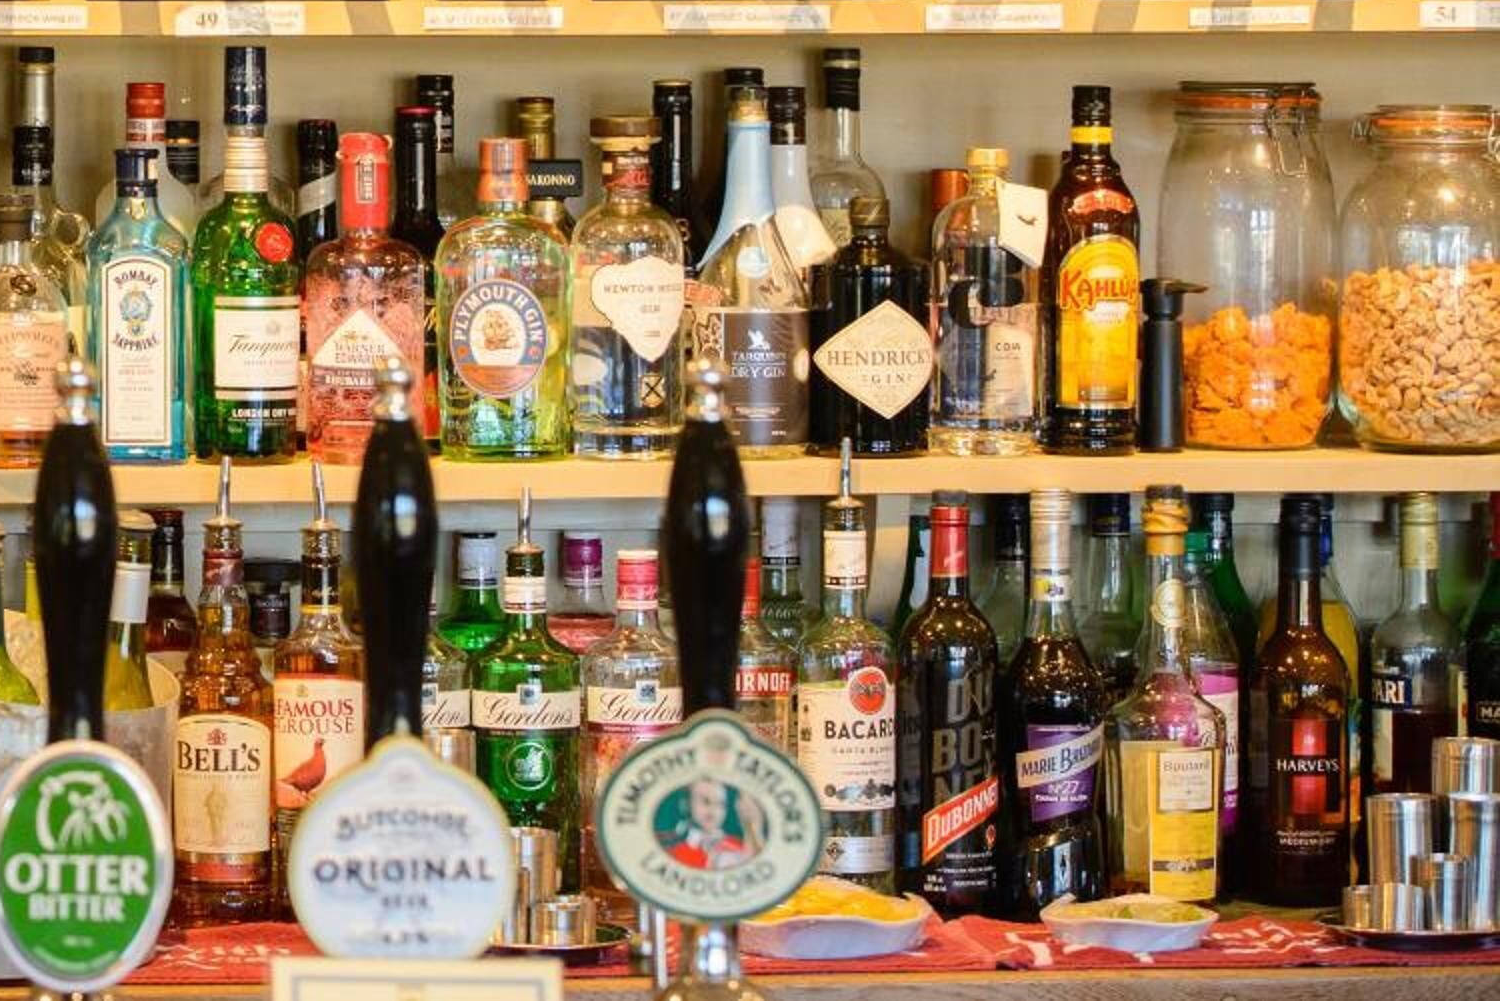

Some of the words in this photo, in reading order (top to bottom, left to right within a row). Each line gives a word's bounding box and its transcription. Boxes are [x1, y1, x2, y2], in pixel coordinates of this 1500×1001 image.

[194, 10, 216, 26] 49
[1434, 5, 1456, 23] 54
[454, 284, 529, 341] PLYMOUTH
[524, 308, 545, 343] GIN
[731, 366, 759, 379] DRY
[762, 366, 787, 379] GIN
[276, 698, 355, 718] FAMOUS
[177, 737, 261, 773] BELL'S
[1021, 755, 1057, 778] MARIE
[1277, 758, 1339, 772] HARVEYS
[616, 748, 697, 826] TIMOTHY
[335, 807, 468, 841] BUTCOMBE
[4, 853, 150, 896] OTTER
[313, 856, 495, 893] ORIGINAL
[641, 849, 776, 899] LANDLORD
[27, 893, 125, 922] BITTER
